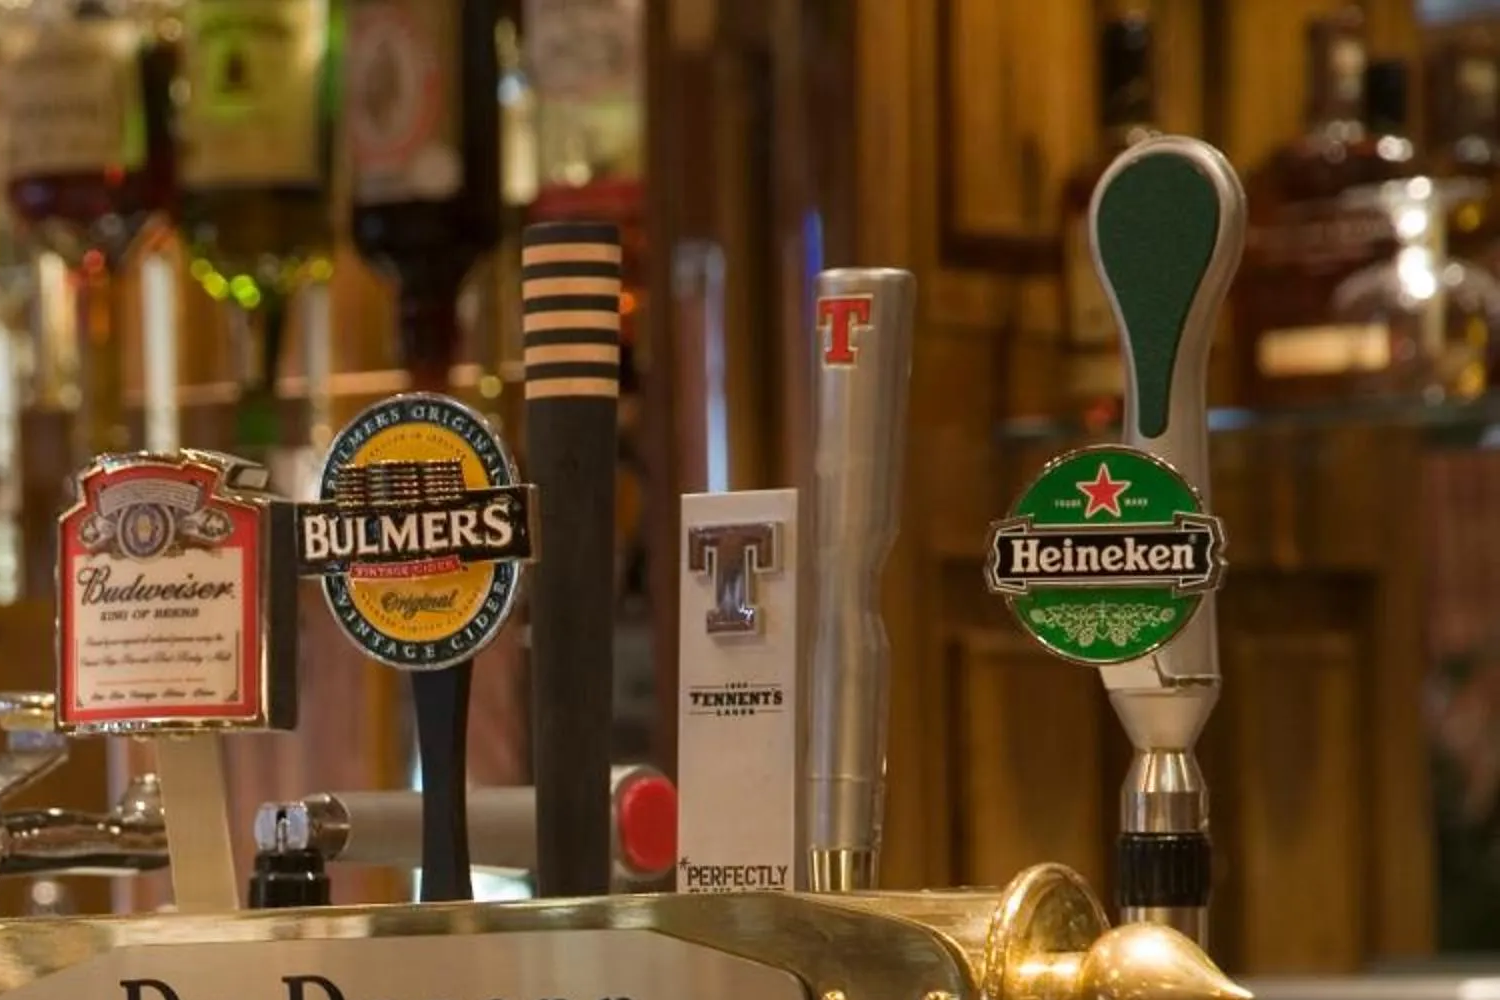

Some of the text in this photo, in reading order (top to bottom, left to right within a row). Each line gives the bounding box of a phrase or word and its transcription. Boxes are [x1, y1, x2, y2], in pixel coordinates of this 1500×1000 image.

[816, 293, 874, 369] T
[303, 501, 514, 560] BULMERS
[1010, 537, 1195, 574] Heineken
[76, 564, 235, 607] Budweiser
[688, 521, 782, 636] T
[338, 589, 437, 658] VINTAGE
[451, 582, 506, 650] CIDER
[689, 687, 784, 707] TENNENT'S
[687, 865, 788, 887] PERFECTLY
